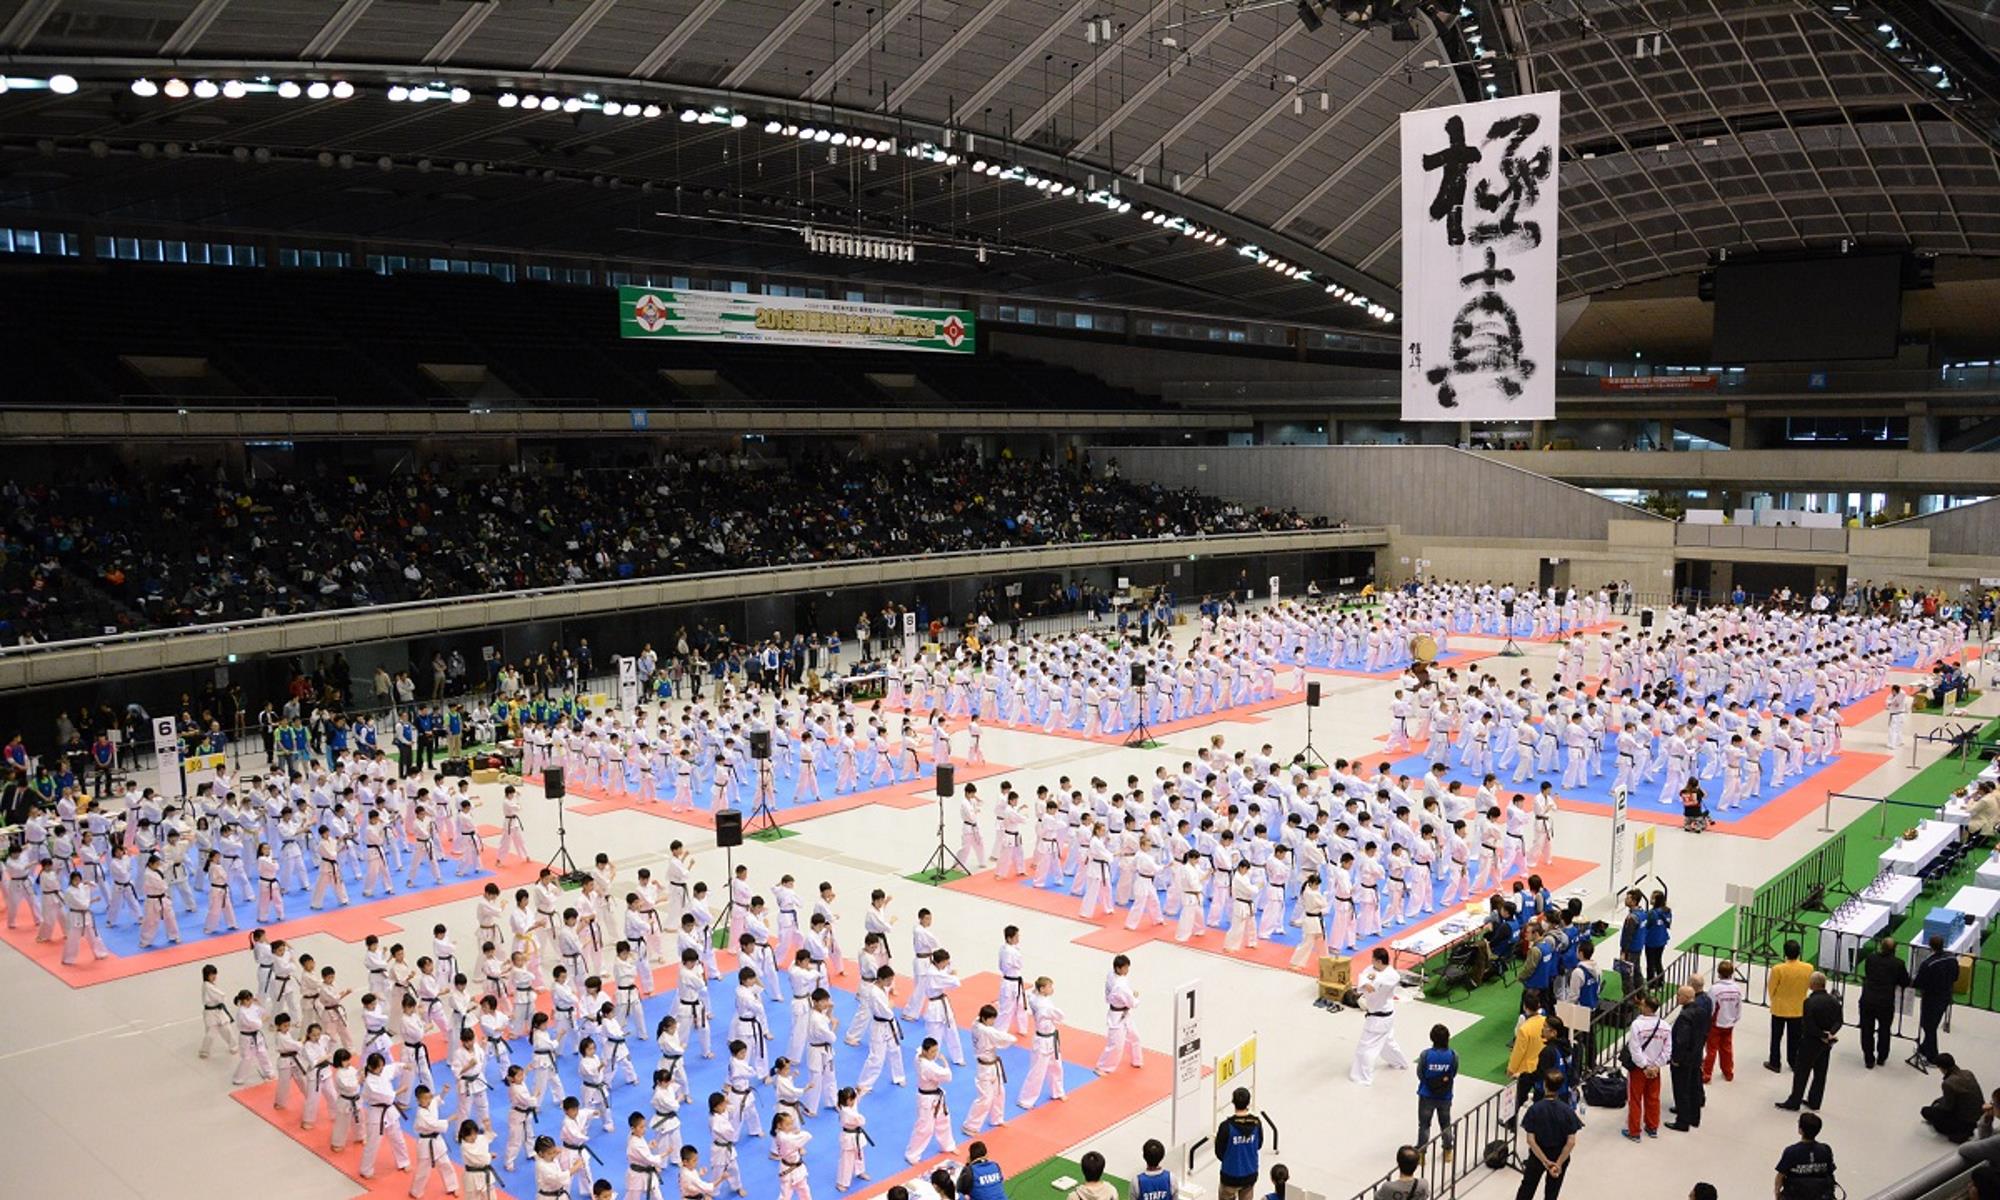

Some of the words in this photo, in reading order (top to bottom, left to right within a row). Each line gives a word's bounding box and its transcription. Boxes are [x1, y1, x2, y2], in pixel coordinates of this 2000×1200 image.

[906, 615, 914, 626] 8
[623, 661, 632, 672] 7
[159, 721, 172, 735] 6
[1618, 791, 1626, 811] 2
[1186, 989, 1196, 1019] 1
